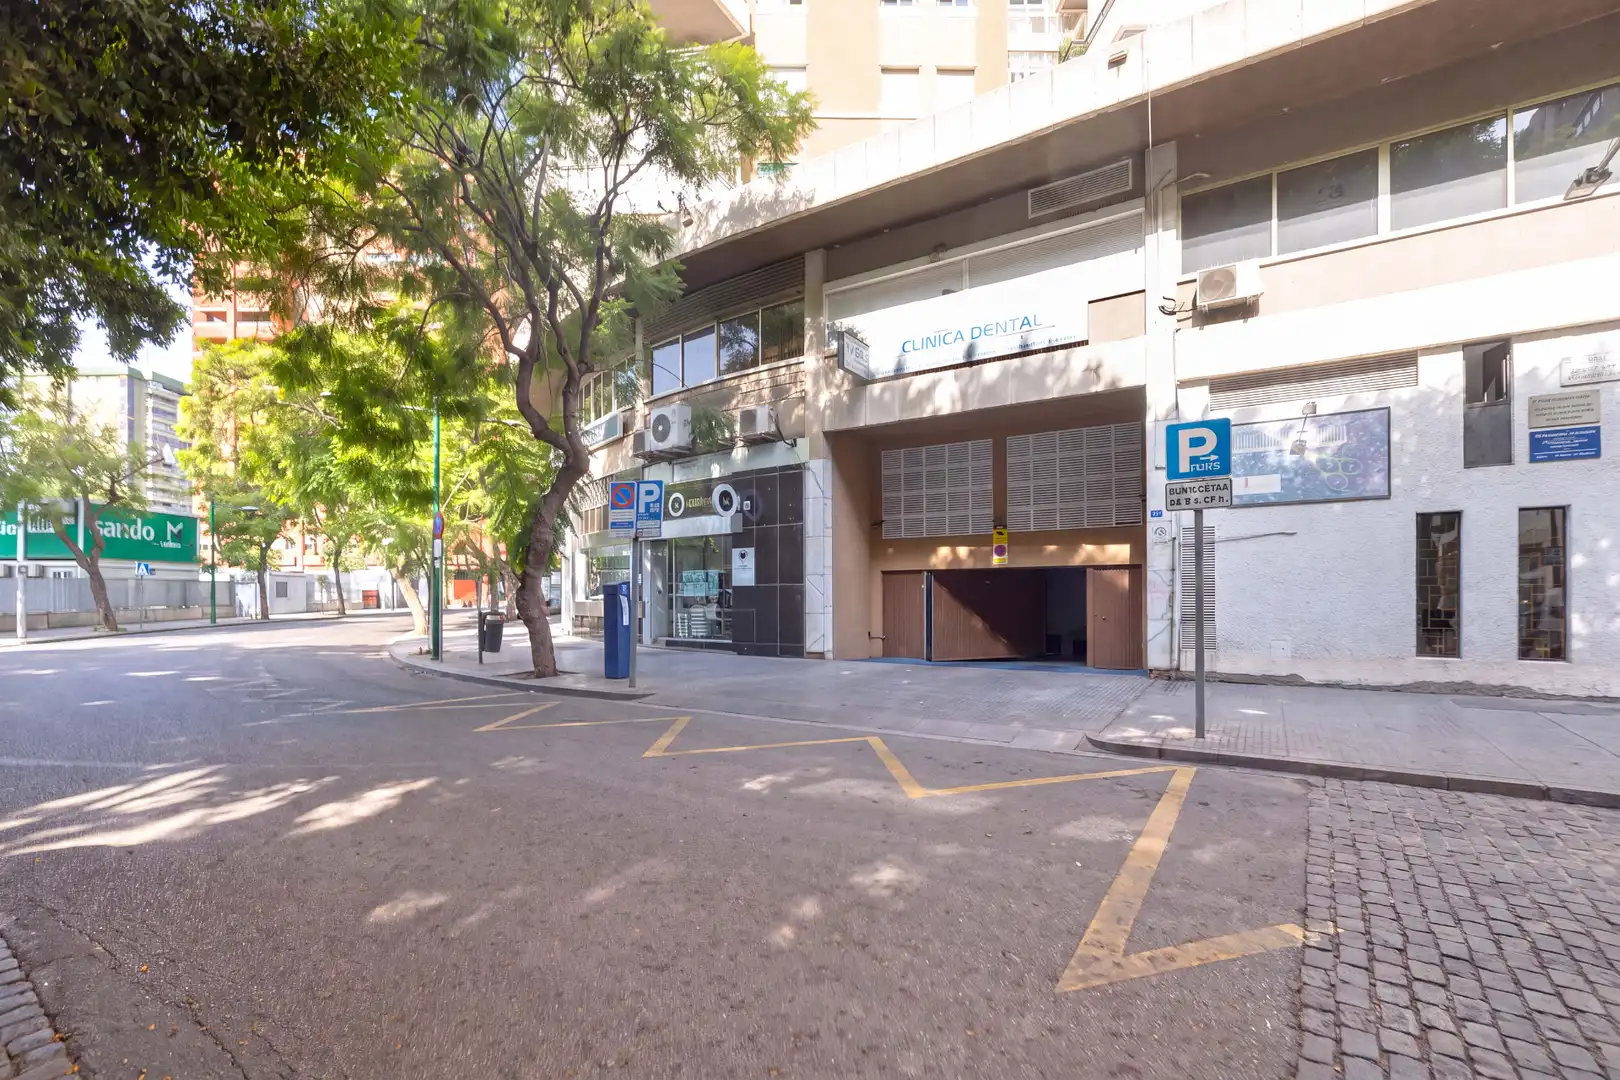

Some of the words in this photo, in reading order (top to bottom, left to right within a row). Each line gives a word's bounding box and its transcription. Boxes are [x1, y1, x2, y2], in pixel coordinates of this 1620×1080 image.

[902, 330, 964, 353] CLINICA
[971, 314, 1042, 340] DENTAL
[1178, 427, 1218, 473] P
[638, 483, 660, 513] P
